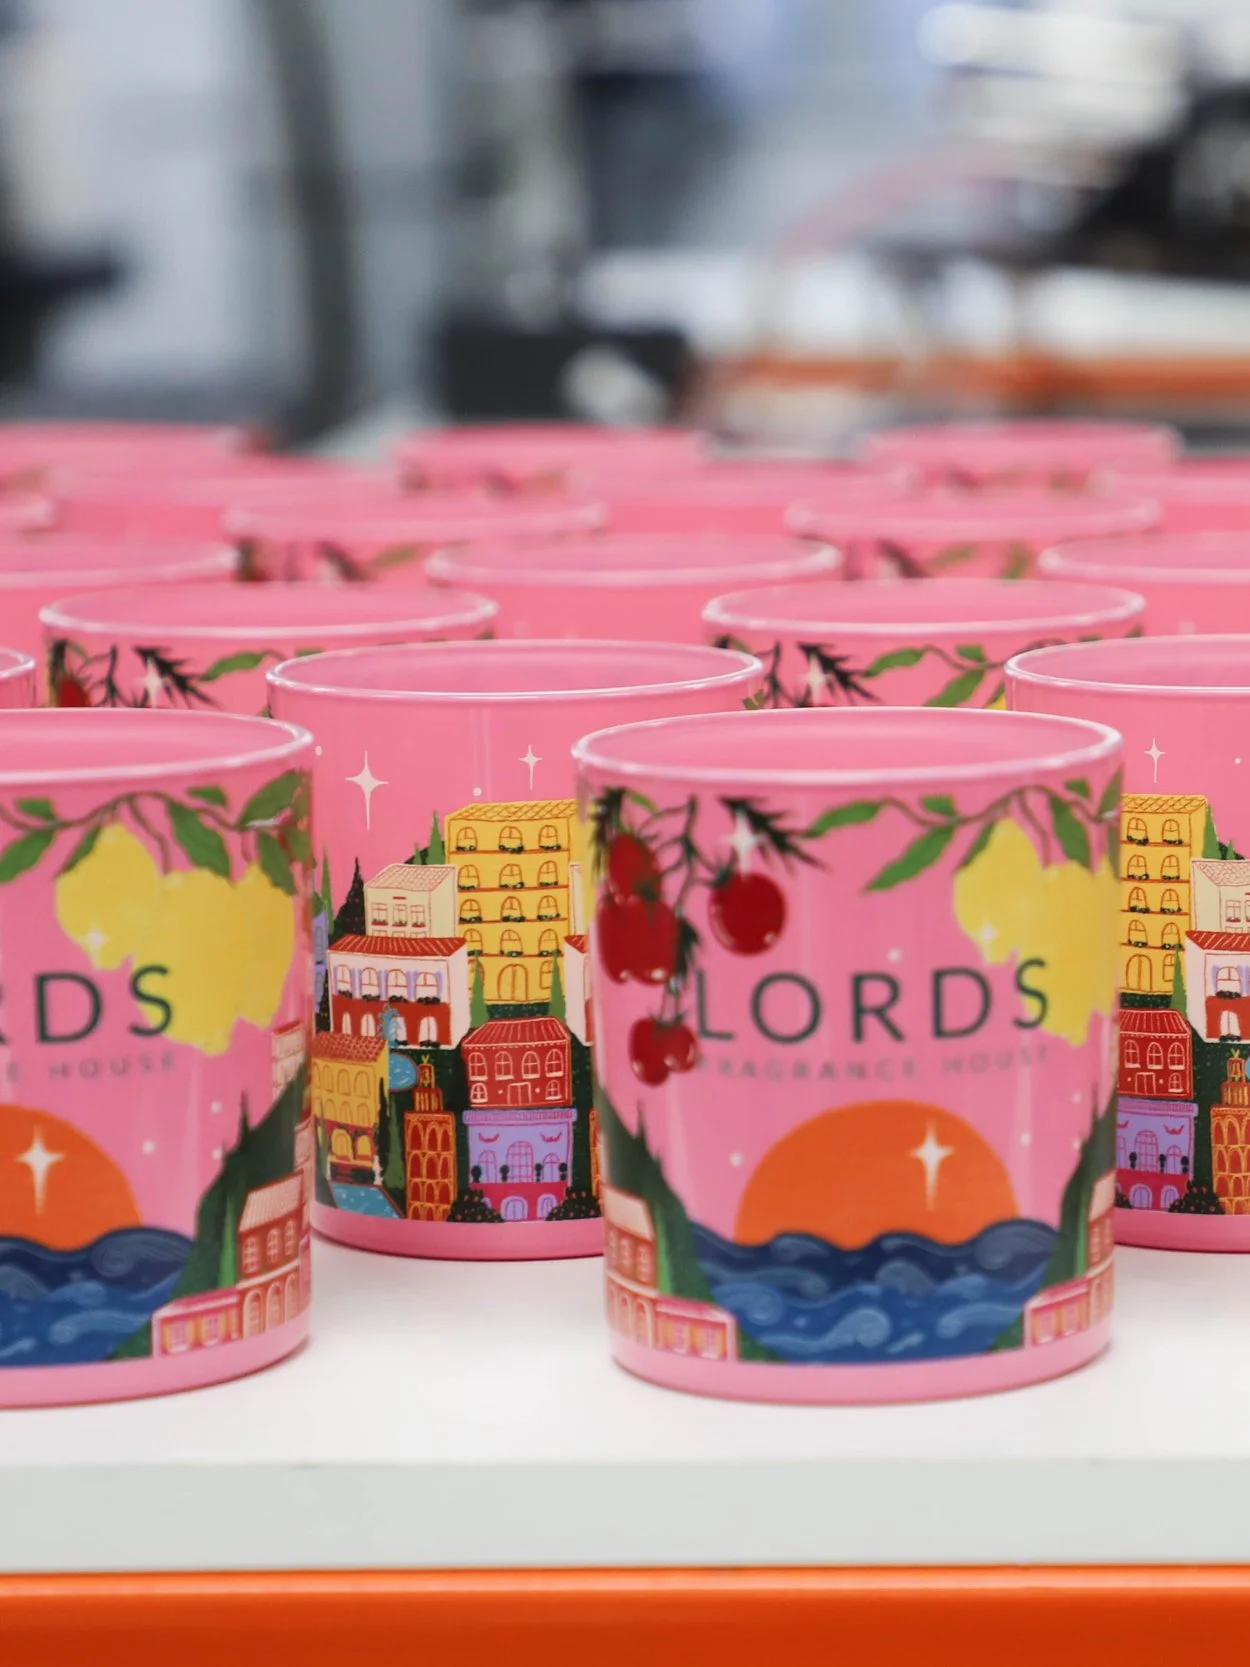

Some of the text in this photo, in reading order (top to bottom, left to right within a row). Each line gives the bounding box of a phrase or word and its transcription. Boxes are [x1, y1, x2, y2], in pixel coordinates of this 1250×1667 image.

[0, 964, 174, 1044] DS
[695, 957, 1050, 1045] LORDS
[48, 1050, 175, 1082] HOUSE
